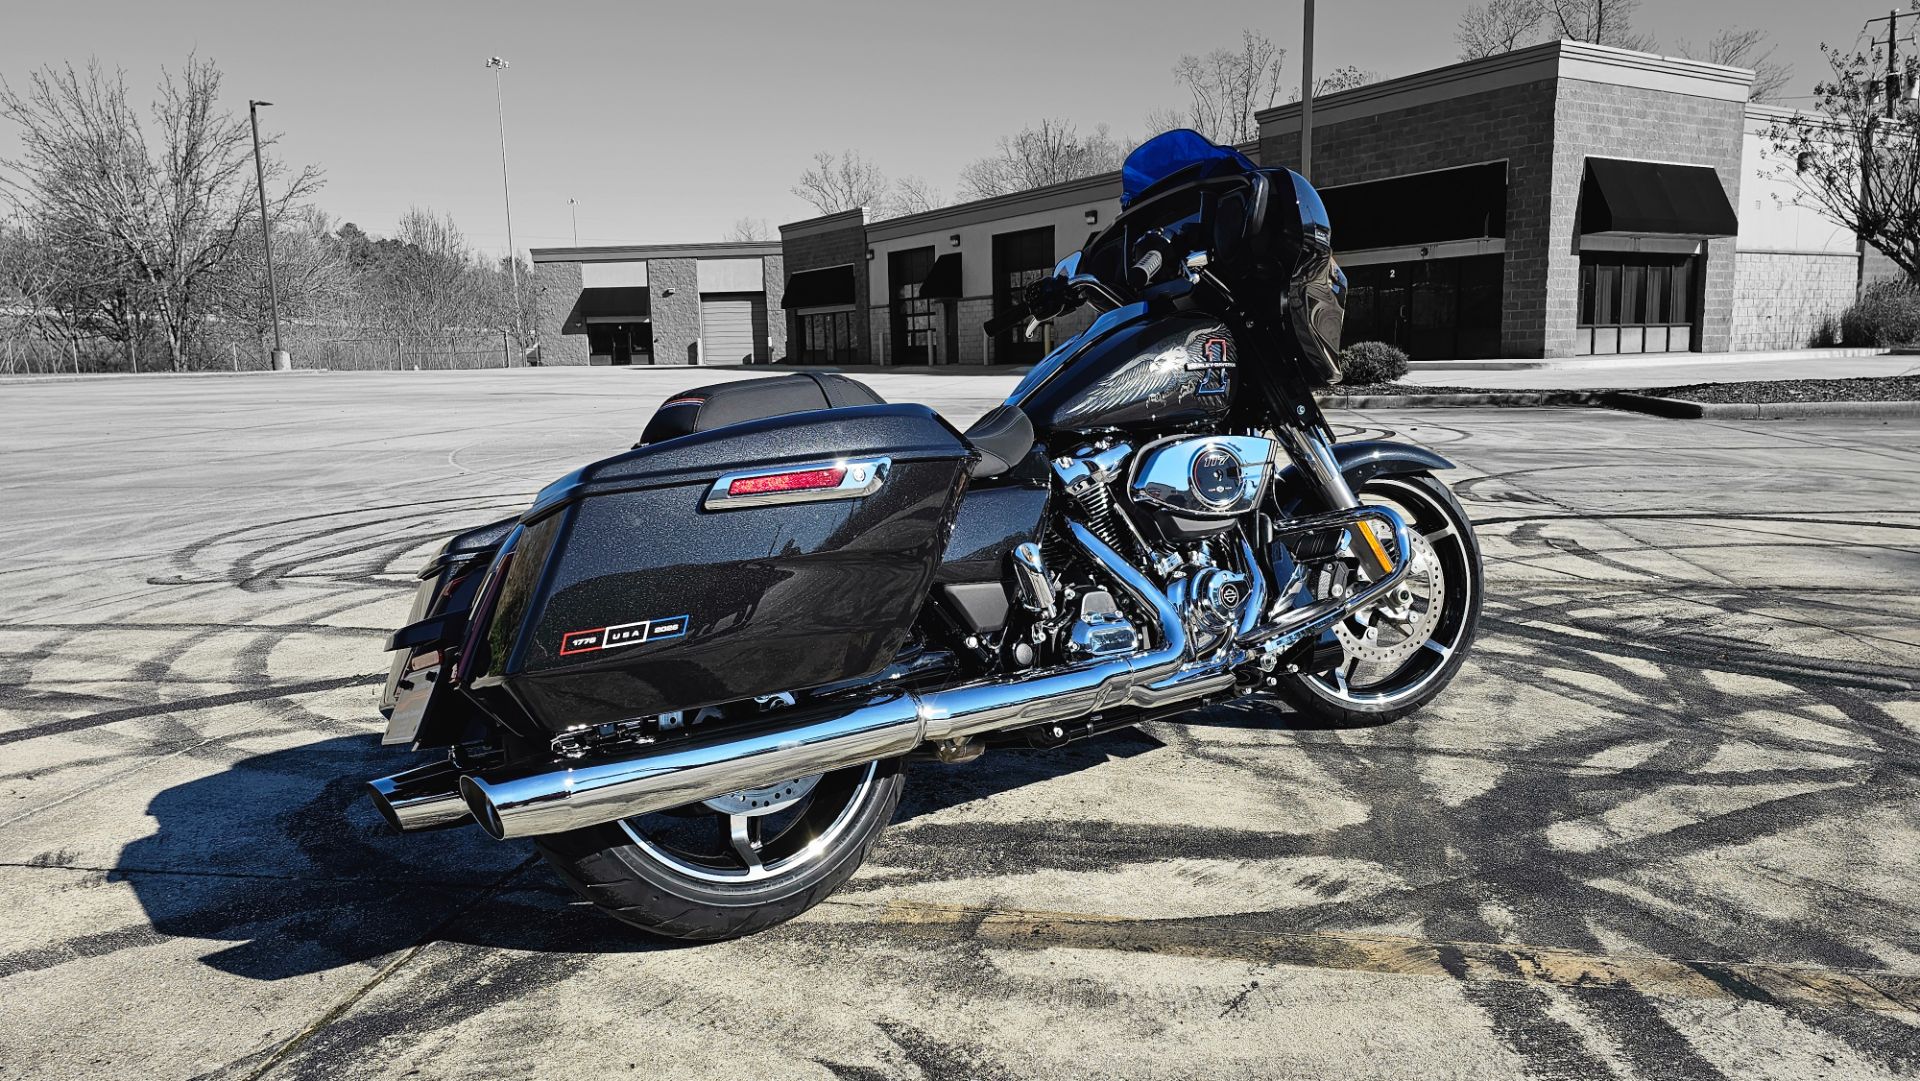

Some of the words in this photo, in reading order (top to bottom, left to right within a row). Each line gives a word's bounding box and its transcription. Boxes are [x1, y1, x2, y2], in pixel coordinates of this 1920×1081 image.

[1389, 269, 1396, 278] 2
[572, 637, 597, 646] 1776
[612, 630, 640, 640] USA
